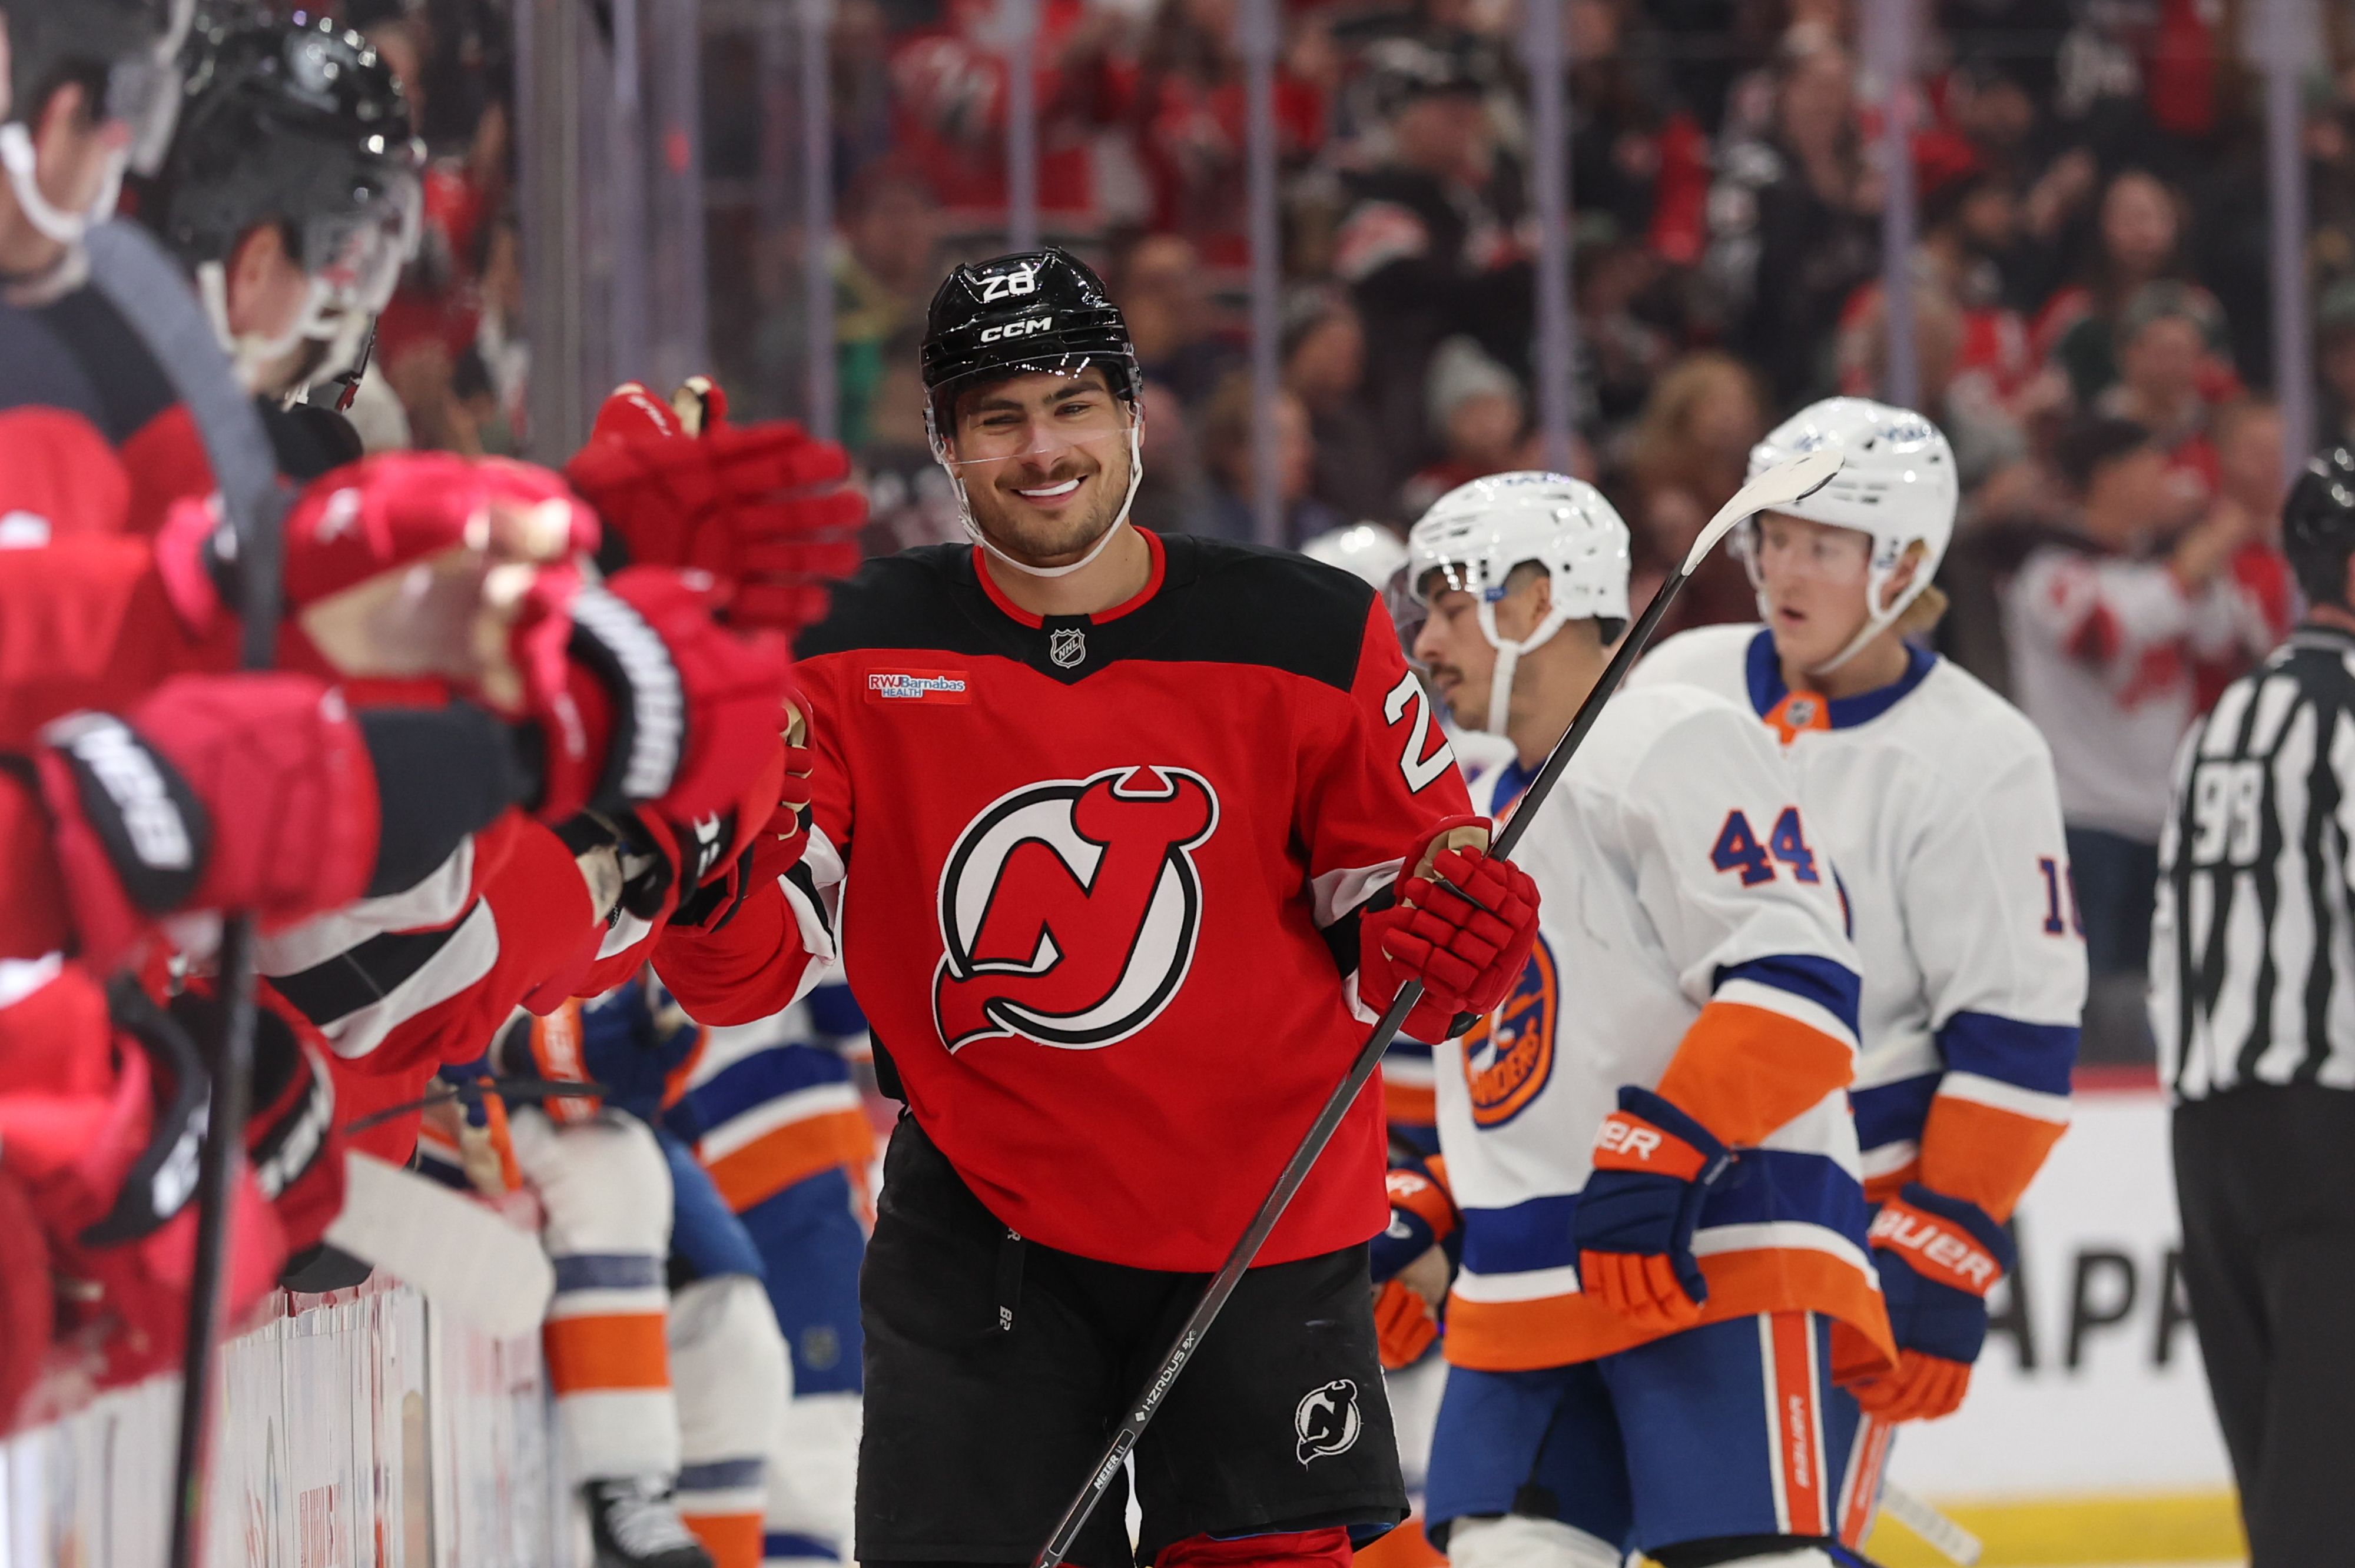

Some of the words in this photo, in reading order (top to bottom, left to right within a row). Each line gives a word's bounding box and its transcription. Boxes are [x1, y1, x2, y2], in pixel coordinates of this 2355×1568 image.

[980, 317, 1052, 343] CCM
[1059, 639, 1079, 660] NHL
[870, 676, 965, 691] RWJBarnabas
[883, 688, 922, 697] HEALTH
[1710, 805, 1822, 888] 44
[1142, 1349, 1185, 1411] HZRDUS
[1093, 1454, 1119, 1490] MEIER
